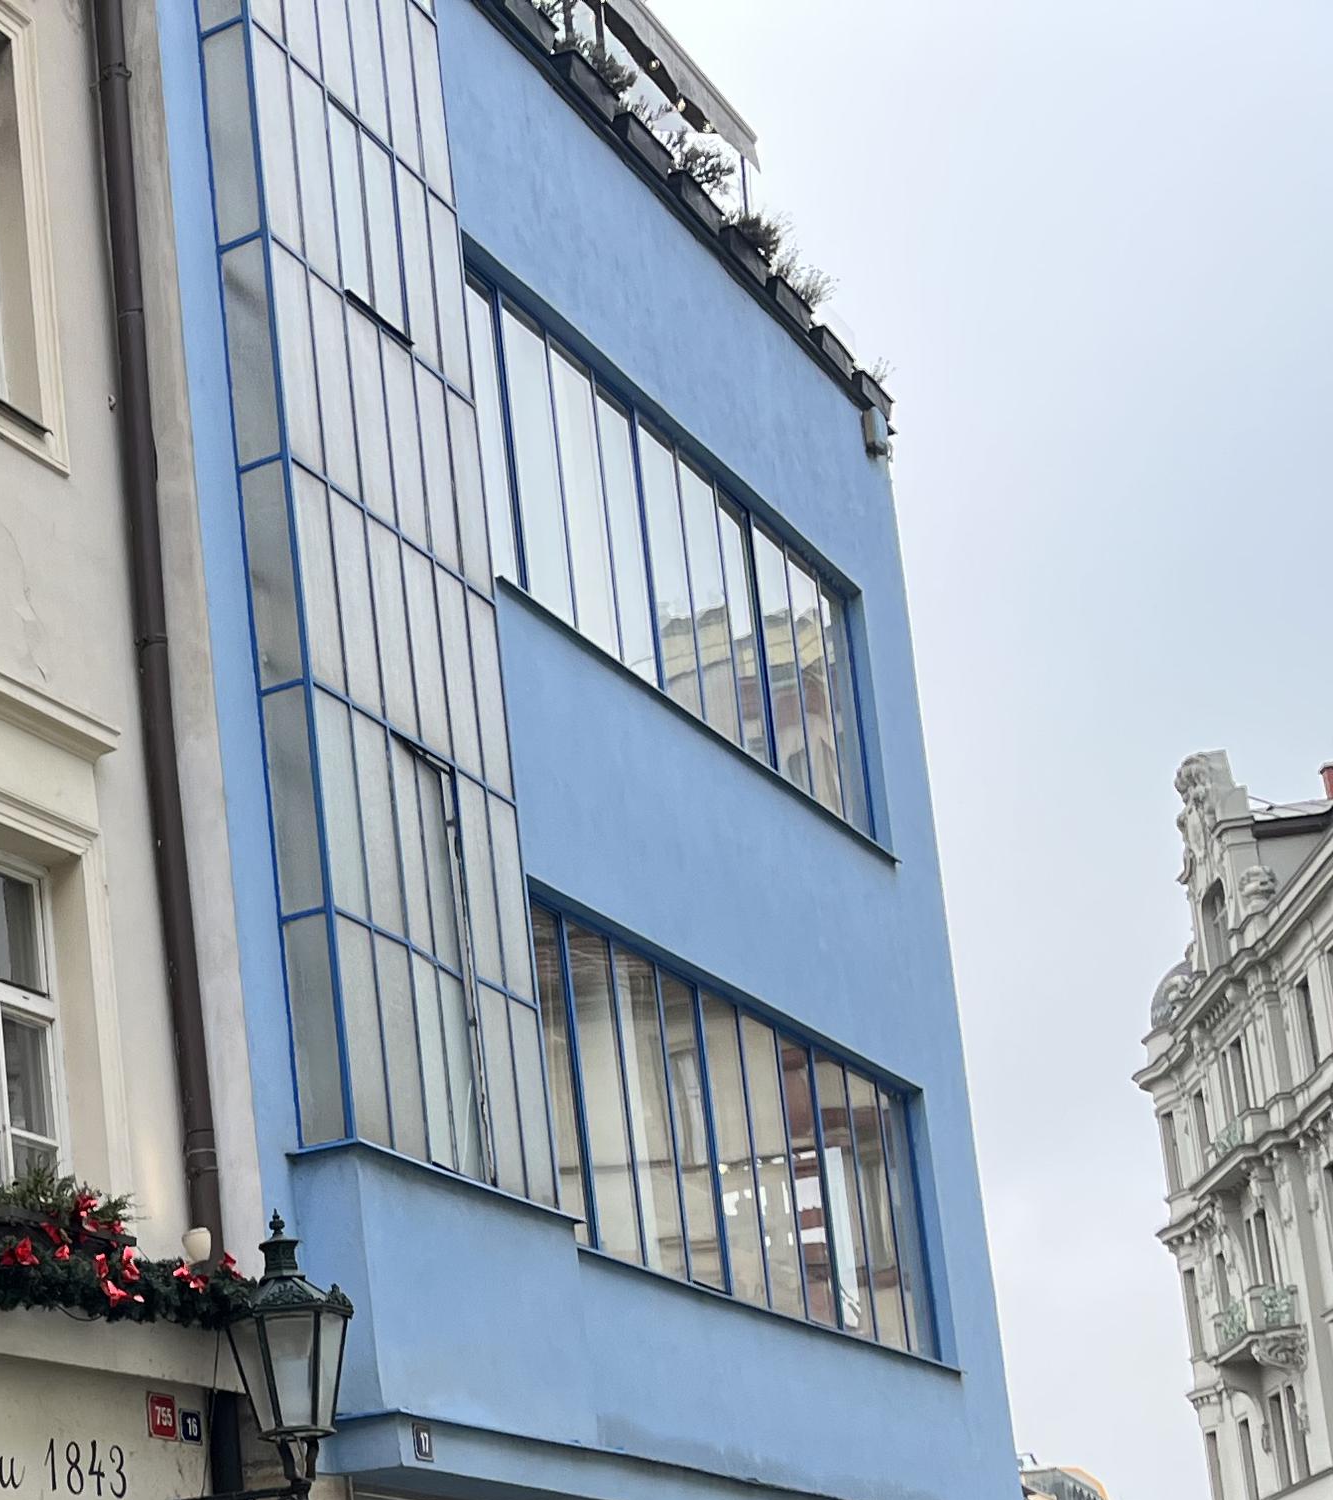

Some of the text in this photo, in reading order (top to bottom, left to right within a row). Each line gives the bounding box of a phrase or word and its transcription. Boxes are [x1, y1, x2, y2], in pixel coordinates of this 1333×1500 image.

[154, 1405, 174, 1428] 755
[185, 1416, 199, 1437] 16
[44, 1437, 129, 1500] 1843
